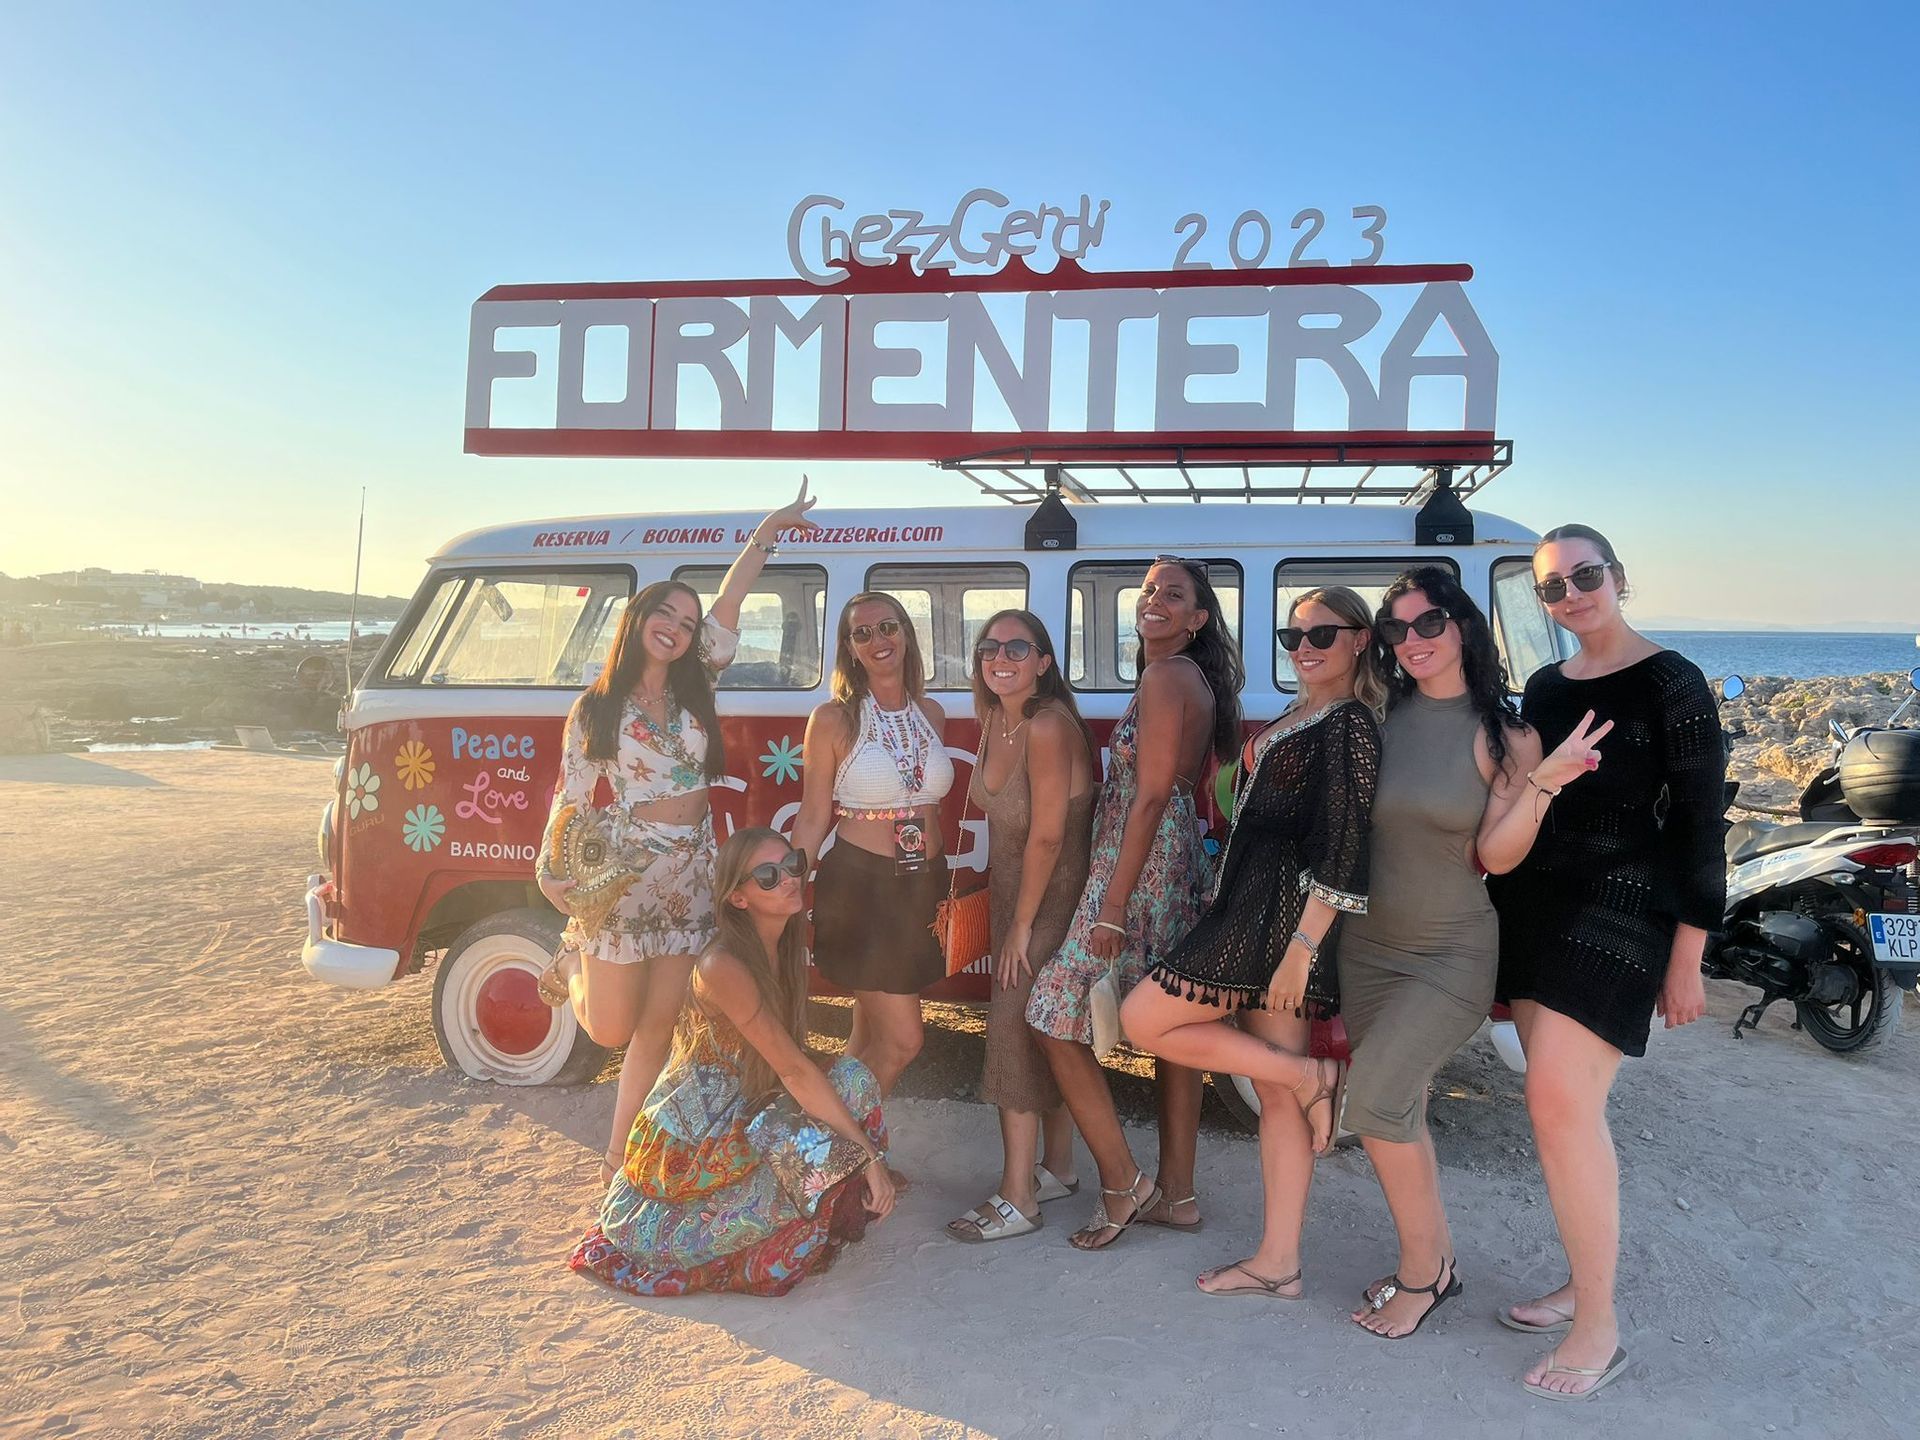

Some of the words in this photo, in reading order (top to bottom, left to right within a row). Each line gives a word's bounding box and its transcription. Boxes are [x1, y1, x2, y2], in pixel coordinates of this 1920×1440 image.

[787, 188, 1111, 286] ChezzGerdi
[1172, 205, 1387, 271] 2023
[464, 281, 1500, 432] FORMENTERA
[533, 530, 611, 547] RESERVA
[642, 527, 725, 544] BOOKING
[451, 727, 536, 760] Peace
[496, 766, 530, 782] and
[455, 771, 529, 824] Love
[450, 841, 536, 861] BARONIO
[1885, 917, 1920, 937] 329
[1888, 939, 1918, 958] KLP
